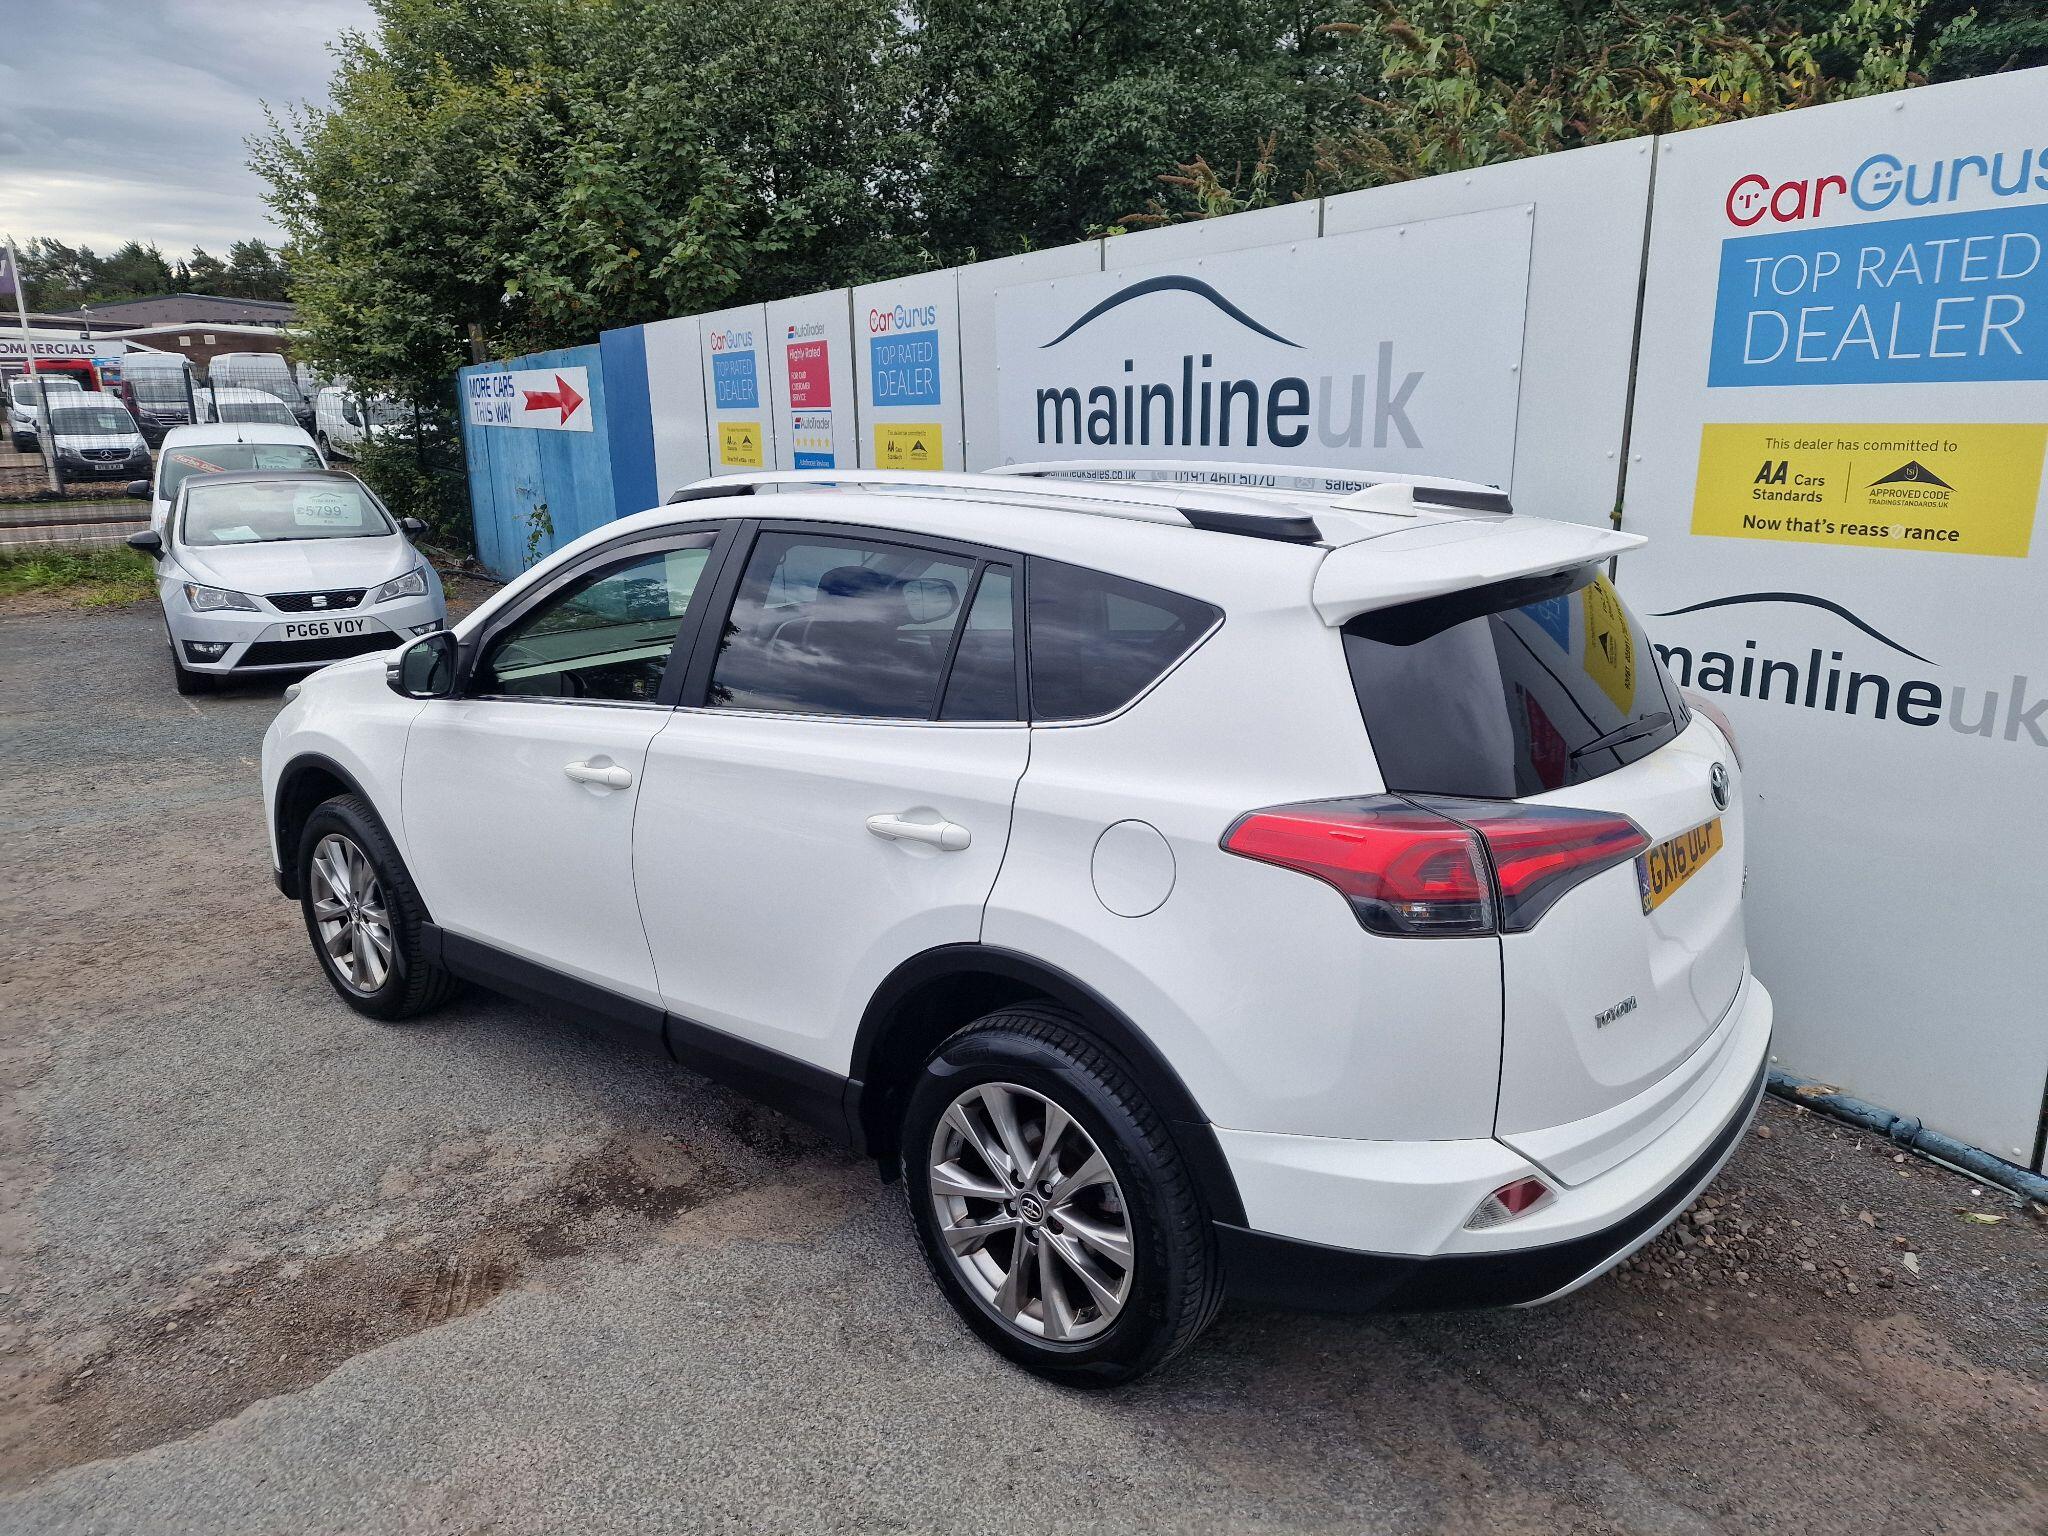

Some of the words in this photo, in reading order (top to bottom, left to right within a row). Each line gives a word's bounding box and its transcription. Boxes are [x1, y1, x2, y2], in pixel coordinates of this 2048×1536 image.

[1745, 251, 1841, 298] TOP
[1856, 232, 2041, 290] RATED
[869, 304, 936, 333] CarGurus
[1743, 294, 2026, 365] DEALER
[710, 330, 753, 351] CarGurus
[875, 345, 896, 366] TOP
[898, 341, 933, 364] RATED
[716, 360, 730, 377] TOP
[730, 358, 753, 375] RATED
[468, 377, 491, 399] MORE
[493, 375, 515, 398] CARS
[718, 379, 755, 401] DEALER
[878, 367, 934, 397] DEALER
[1036, 340, 1425, 449] mainlineuk
[474, 402, 494, 423] THIS
[495, 401, 512, 424] WAY
[1765, 437, 1790, 450] This
[1793, 438, 1834, 450] dealer
[1836, 438, 1860, 451] has
[1863, 439, 1939, 452] committed
[1943, 439, 1958, 452] to
[1753, 460, 1789, 485] AA
[1794, 474, 1825, 487] Cars
[1752, 488, 1823, 503] Standards
[1869, 488, 1921, 500] APPROVED
[1922, 490, 1951, 501] CODE
[1743, 514, 1782, 530] Now
[1786, 517, 1835, 534] that's
[1840, 523, 1960, 542] reassrance
[285, 622, 330, 638] PG66
[334, 619, 364, 634] VOY
[1595, 995, 1638, 1029] TOYOTA
